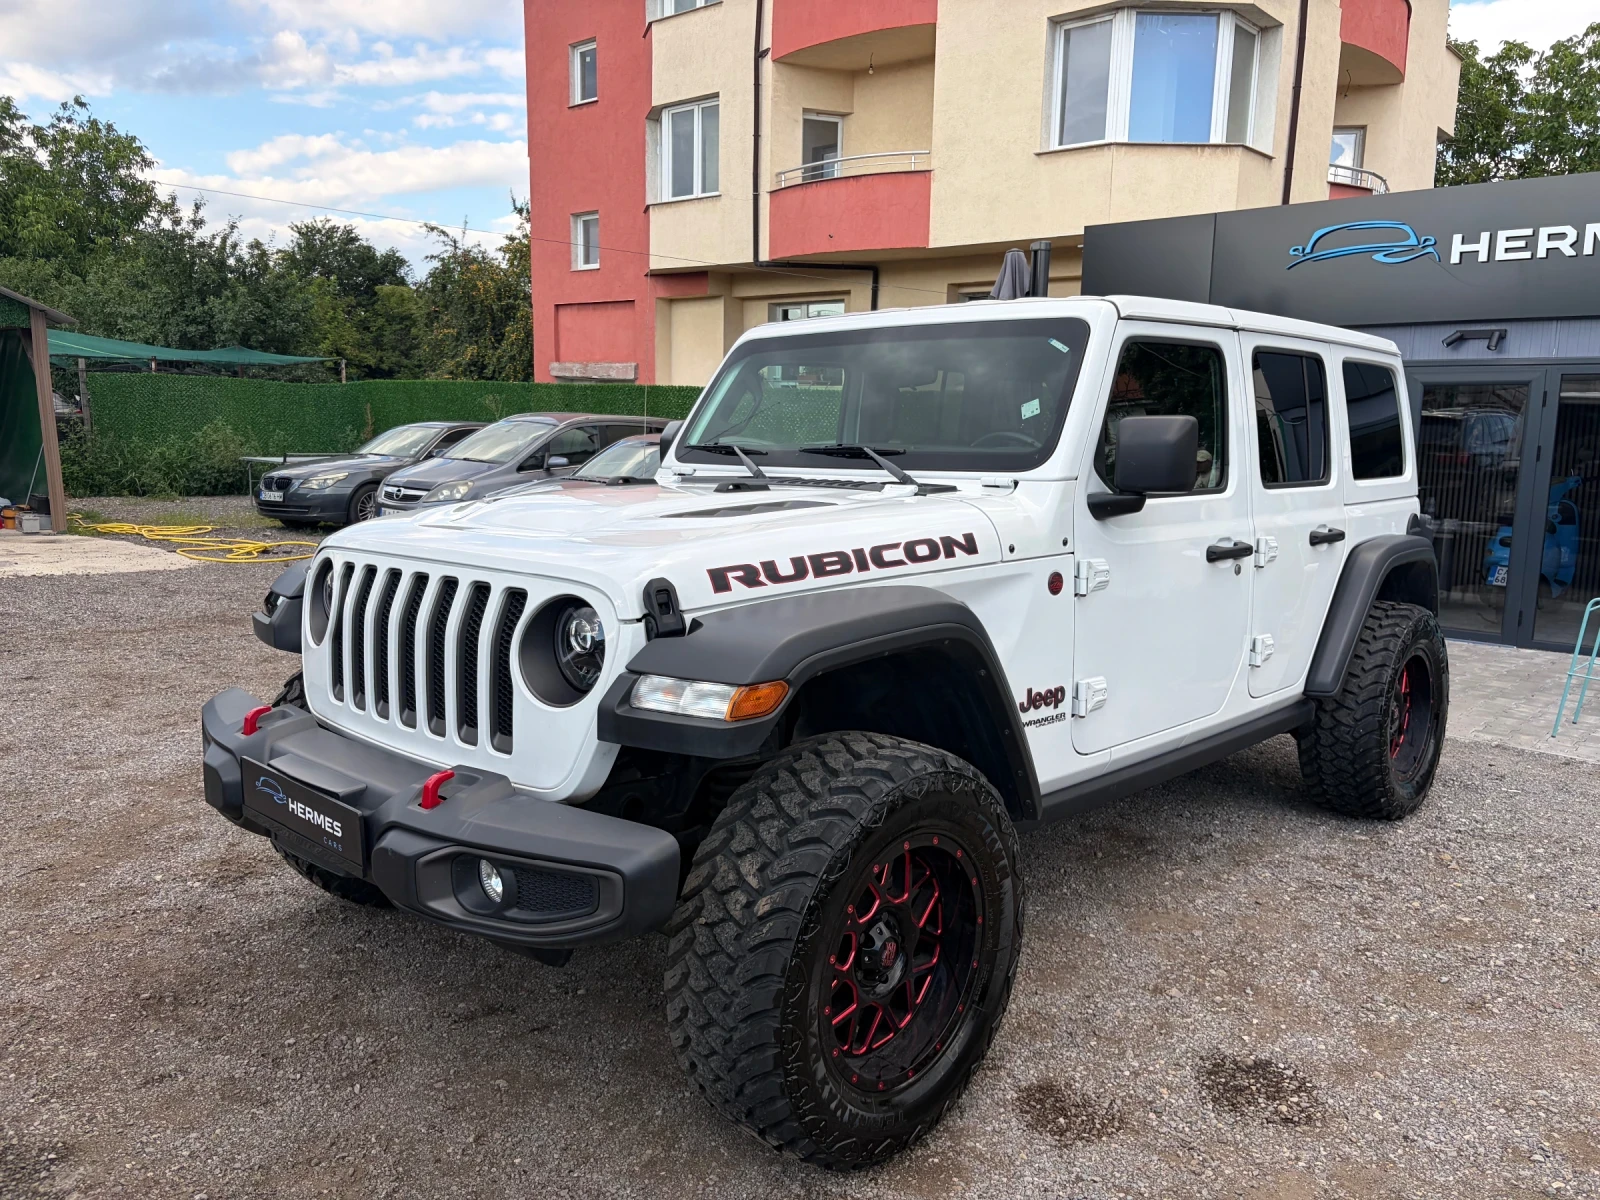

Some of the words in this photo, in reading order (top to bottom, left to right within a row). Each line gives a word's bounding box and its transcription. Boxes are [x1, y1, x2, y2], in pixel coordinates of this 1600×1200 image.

[706, 532, 979, 594] RUBICON
[1019, 685, 1066, 713] Jeep
[1022, 712, 1066, 728] WRANGLER
[288, 797, 342, 837] HERMES
[323, 836, 343, 852] CARS
